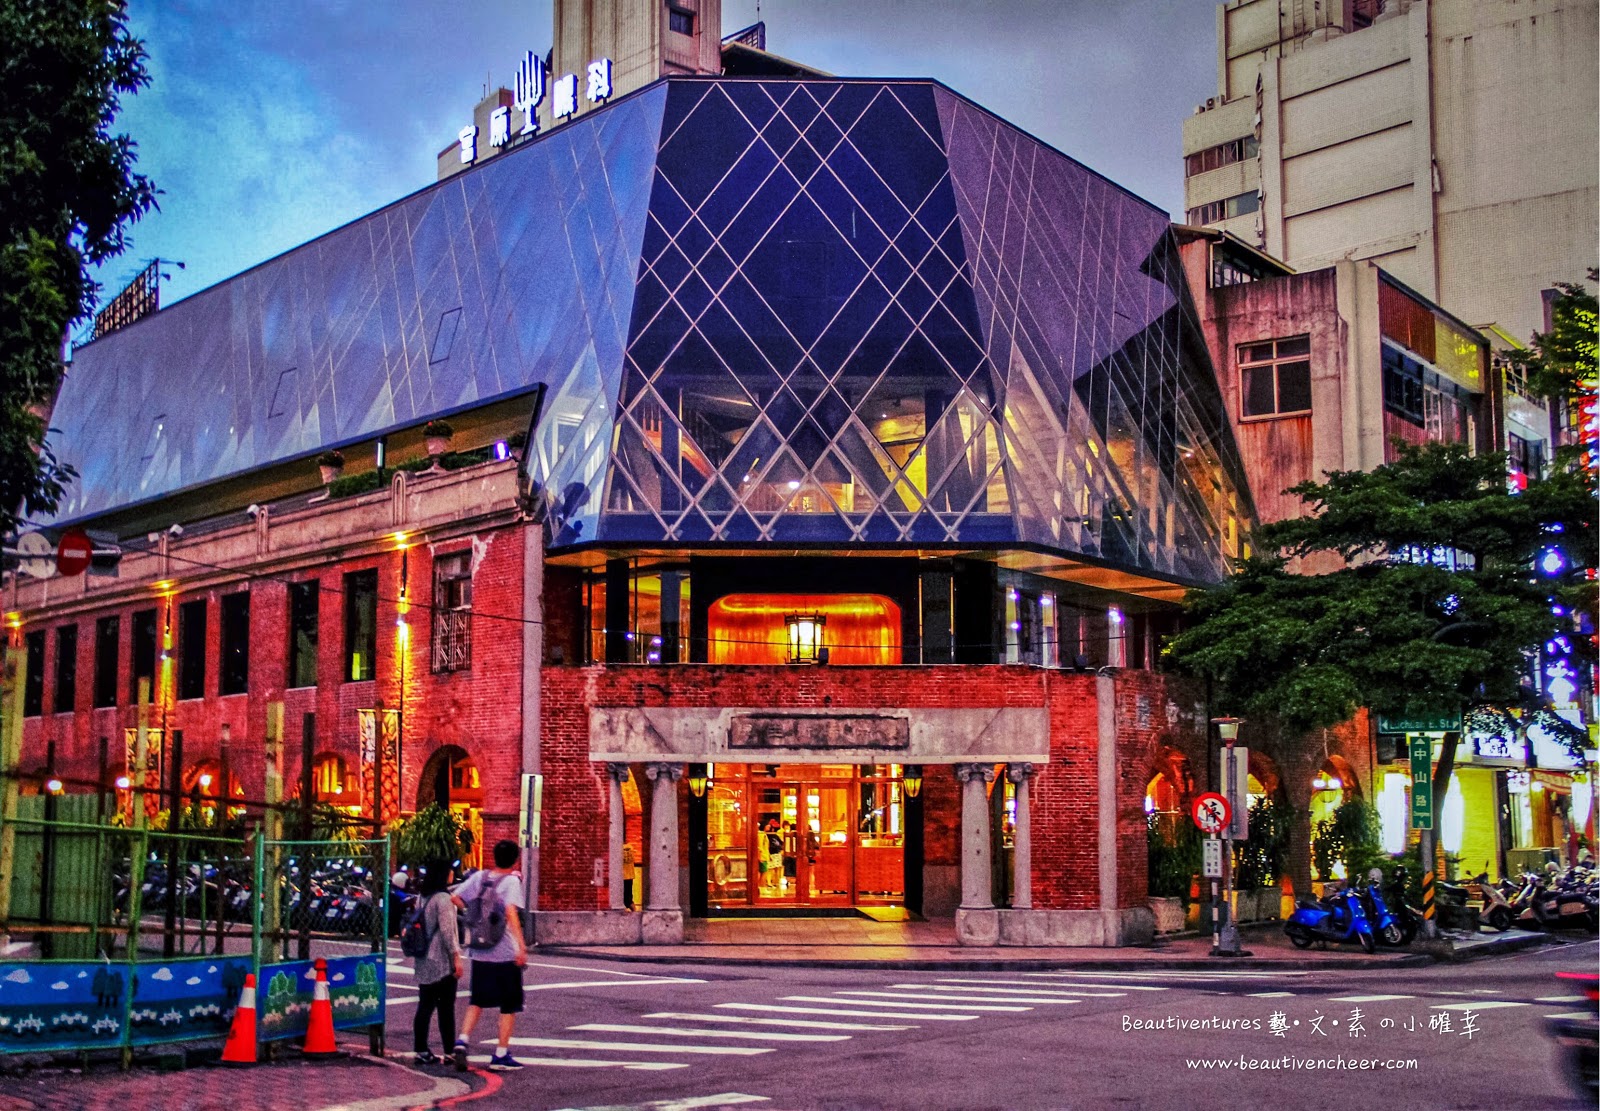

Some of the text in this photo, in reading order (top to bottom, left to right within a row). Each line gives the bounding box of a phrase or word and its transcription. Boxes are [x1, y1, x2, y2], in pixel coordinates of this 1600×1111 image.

[1439, 718, 1452, 729] St.
[1414, 748, 1427, 807] 中山路
[1203, 801, 1221, 823] 停
